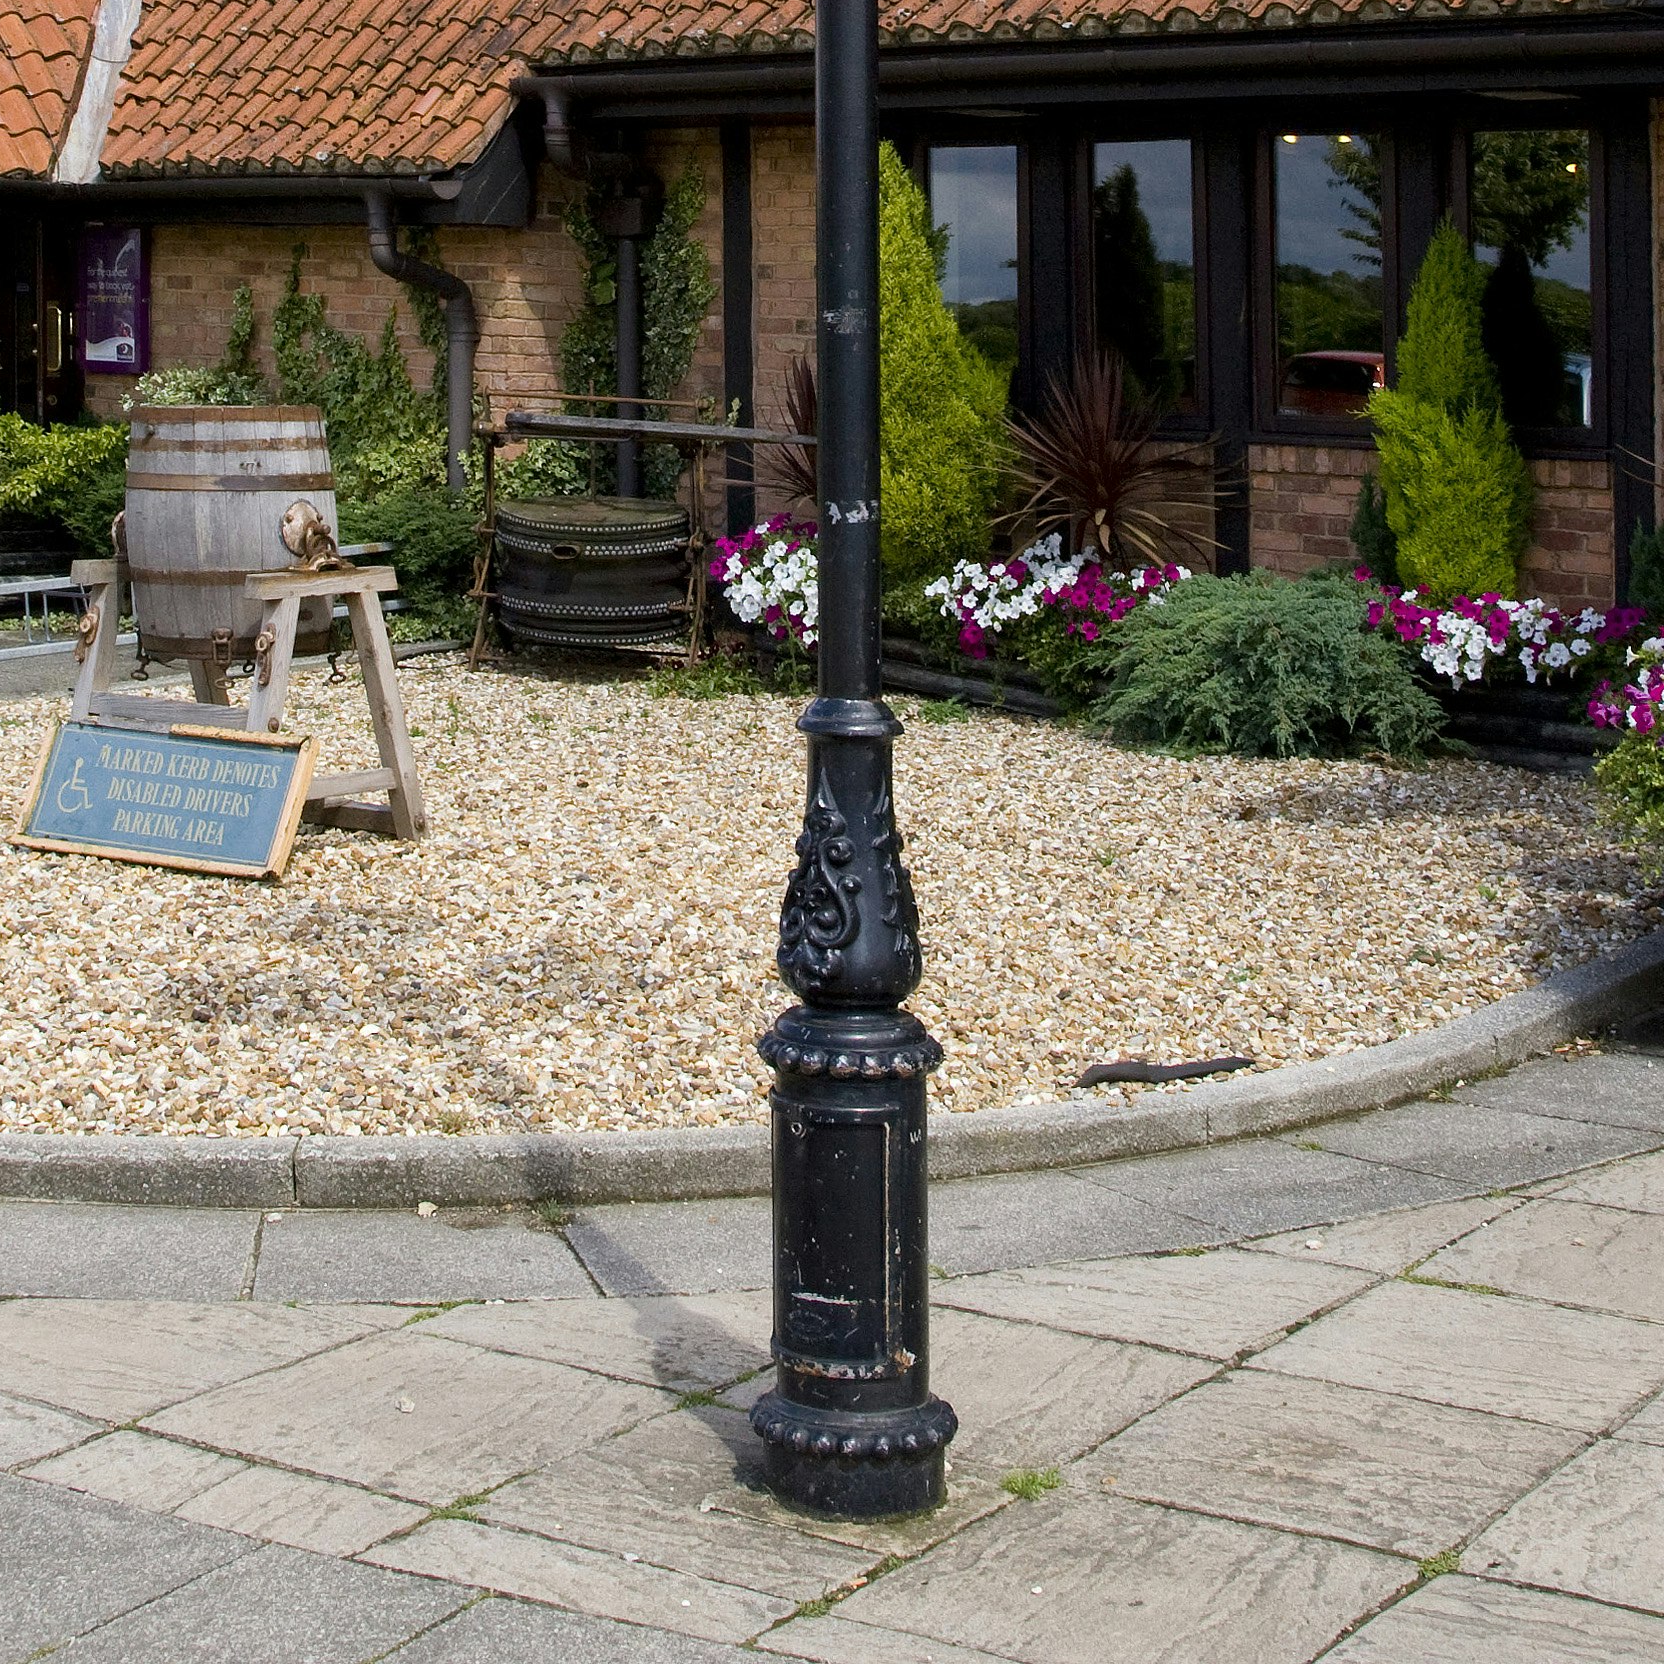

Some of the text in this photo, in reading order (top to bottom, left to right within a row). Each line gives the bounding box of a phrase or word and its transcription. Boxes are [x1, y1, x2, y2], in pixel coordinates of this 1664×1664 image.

[96, 744, 280, 789] MARKED KERB DENOTES
[106, 776, 253, 817] DISABLED DRIVERS
[111, 808, 225, 846] PARKING AREA
